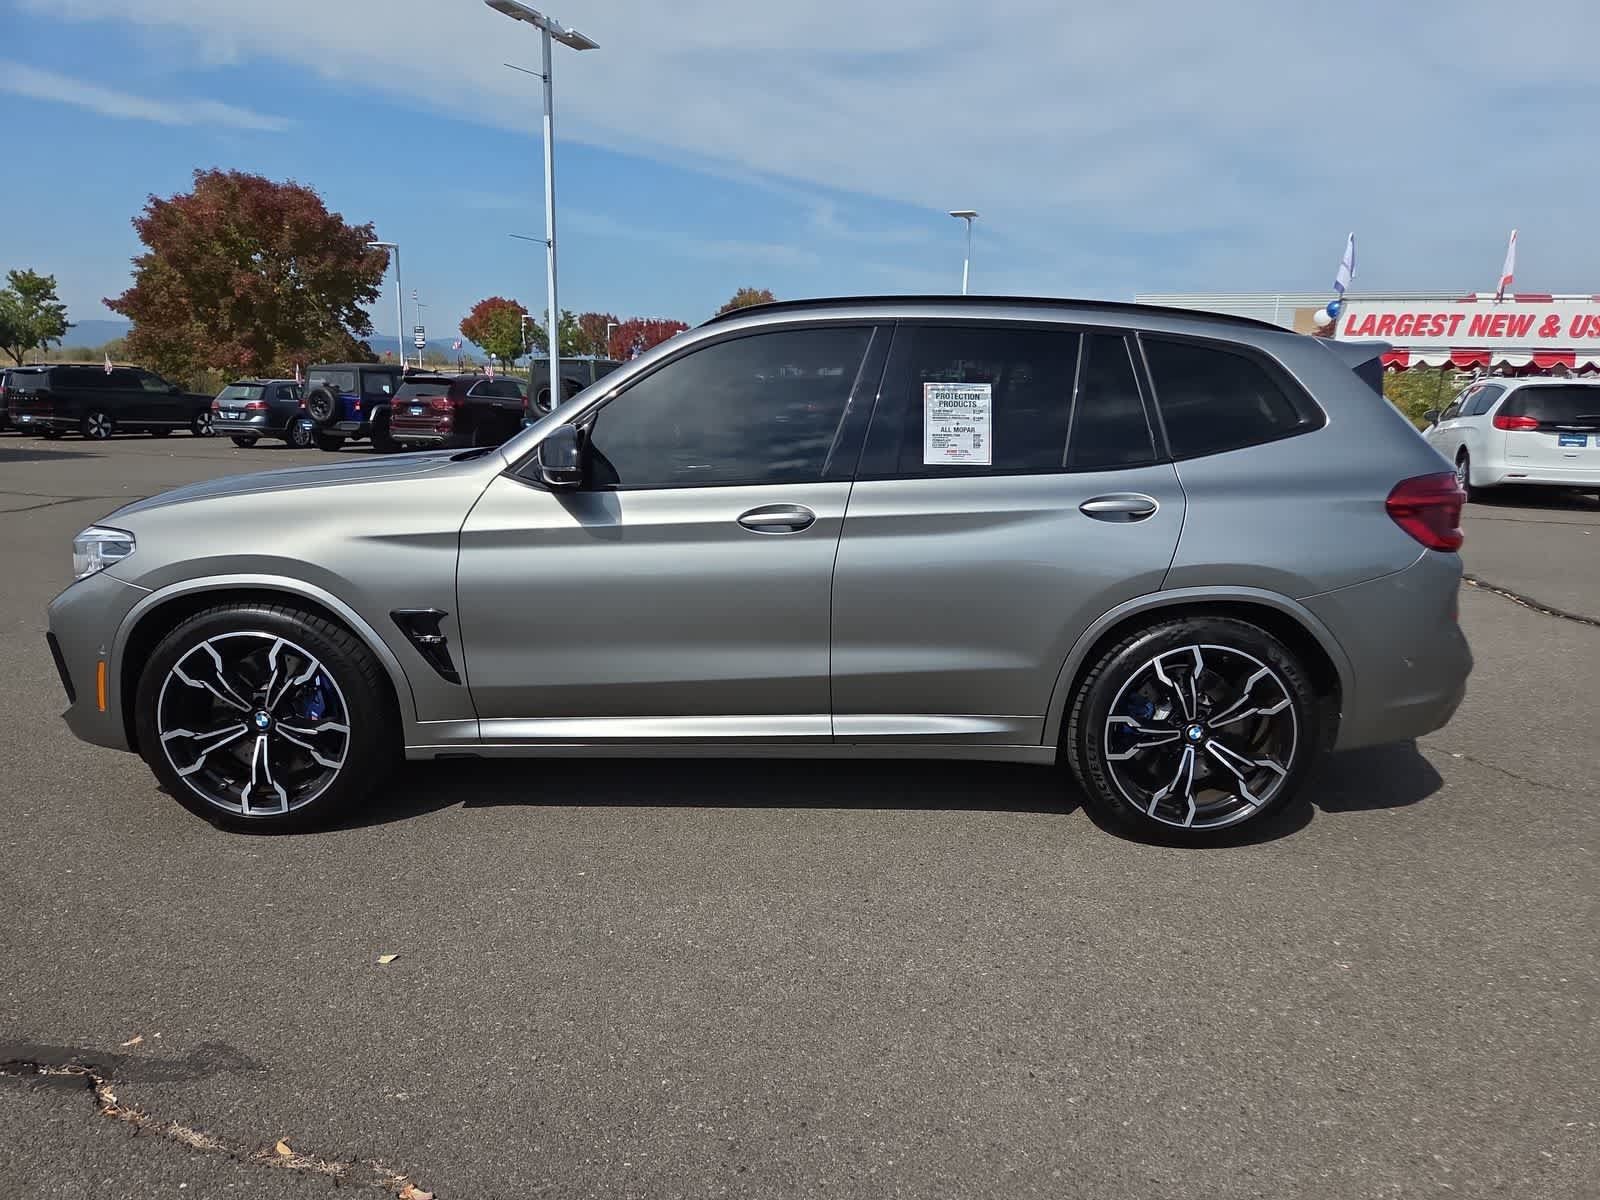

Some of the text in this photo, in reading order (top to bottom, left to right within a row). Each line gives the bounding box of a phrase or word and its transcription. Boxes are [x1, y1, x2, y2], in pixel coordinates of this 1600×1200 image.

[1343, 313, 1465, 338] LARGEST
[1467, 314, 1535, 338] NEW
[1538, 314, 1561, 338] &
[935, 392, 981, 400] PROTECTION
[939, 400, 977, 408] PRODUCTS
